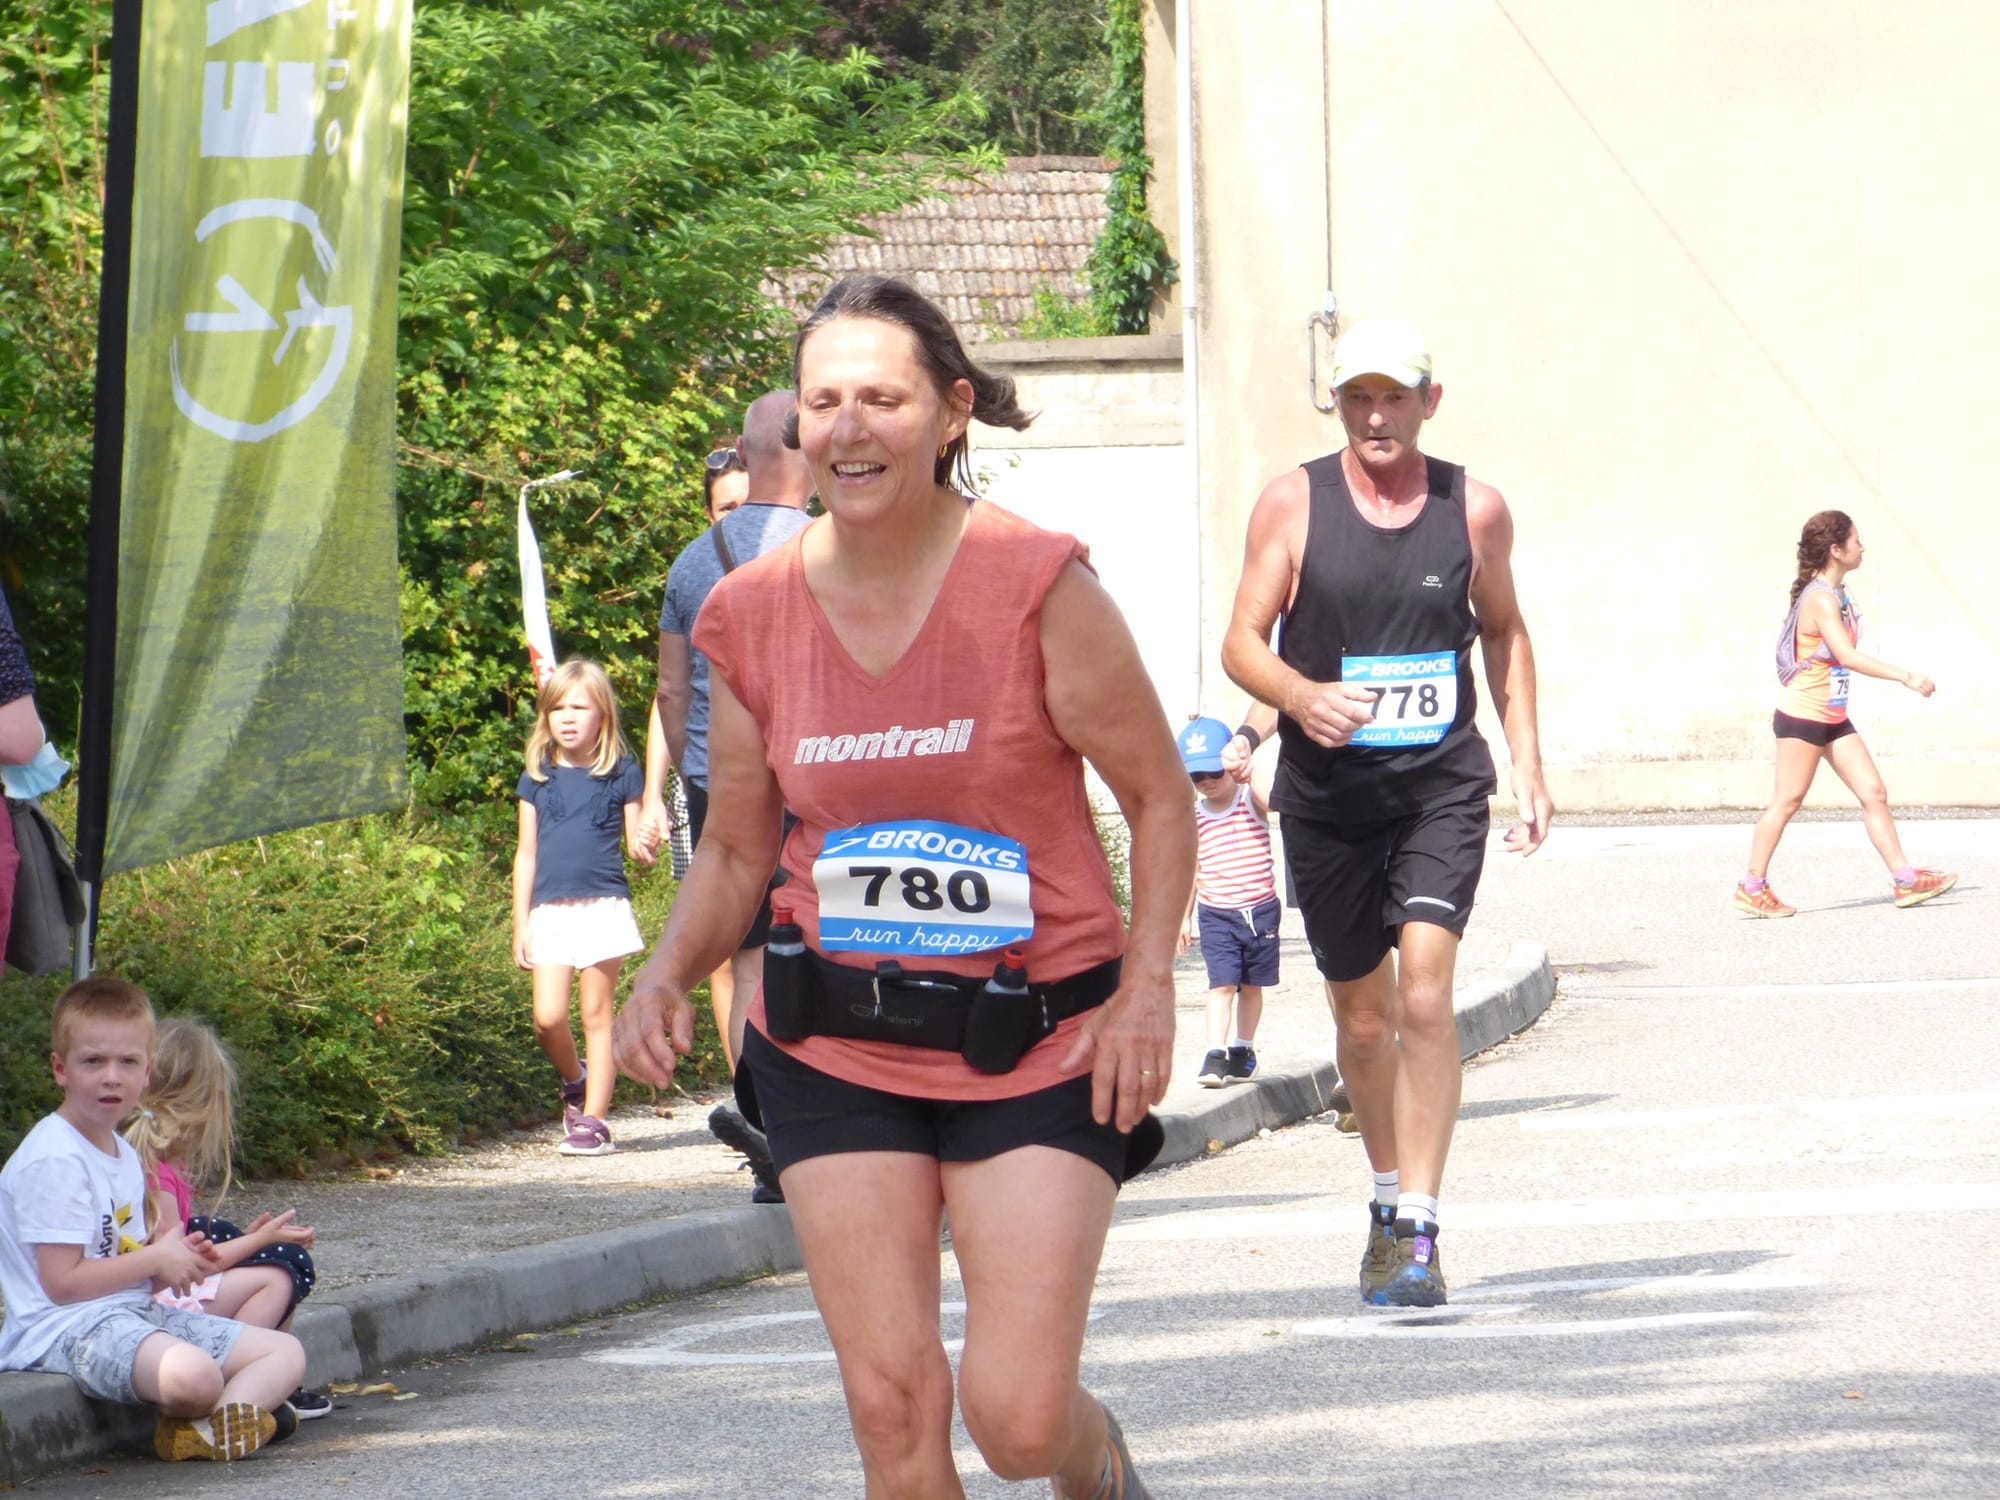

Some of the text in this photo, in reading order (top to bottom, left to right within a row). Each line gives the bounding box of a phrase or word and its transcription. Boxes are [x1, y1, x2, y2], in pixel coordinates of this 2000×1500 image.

[1370, 658, 1452, 677] BROOKS
[1364, 683, 1439, 719] 778
[793, 718, 975, 765] montrail
[1361, 728, 1444, 743] run happy
[867, 829, 1022, 870] BROOKS
[848, 866, 991, 914] 780
[848, 926, 1000, 954] run happy
